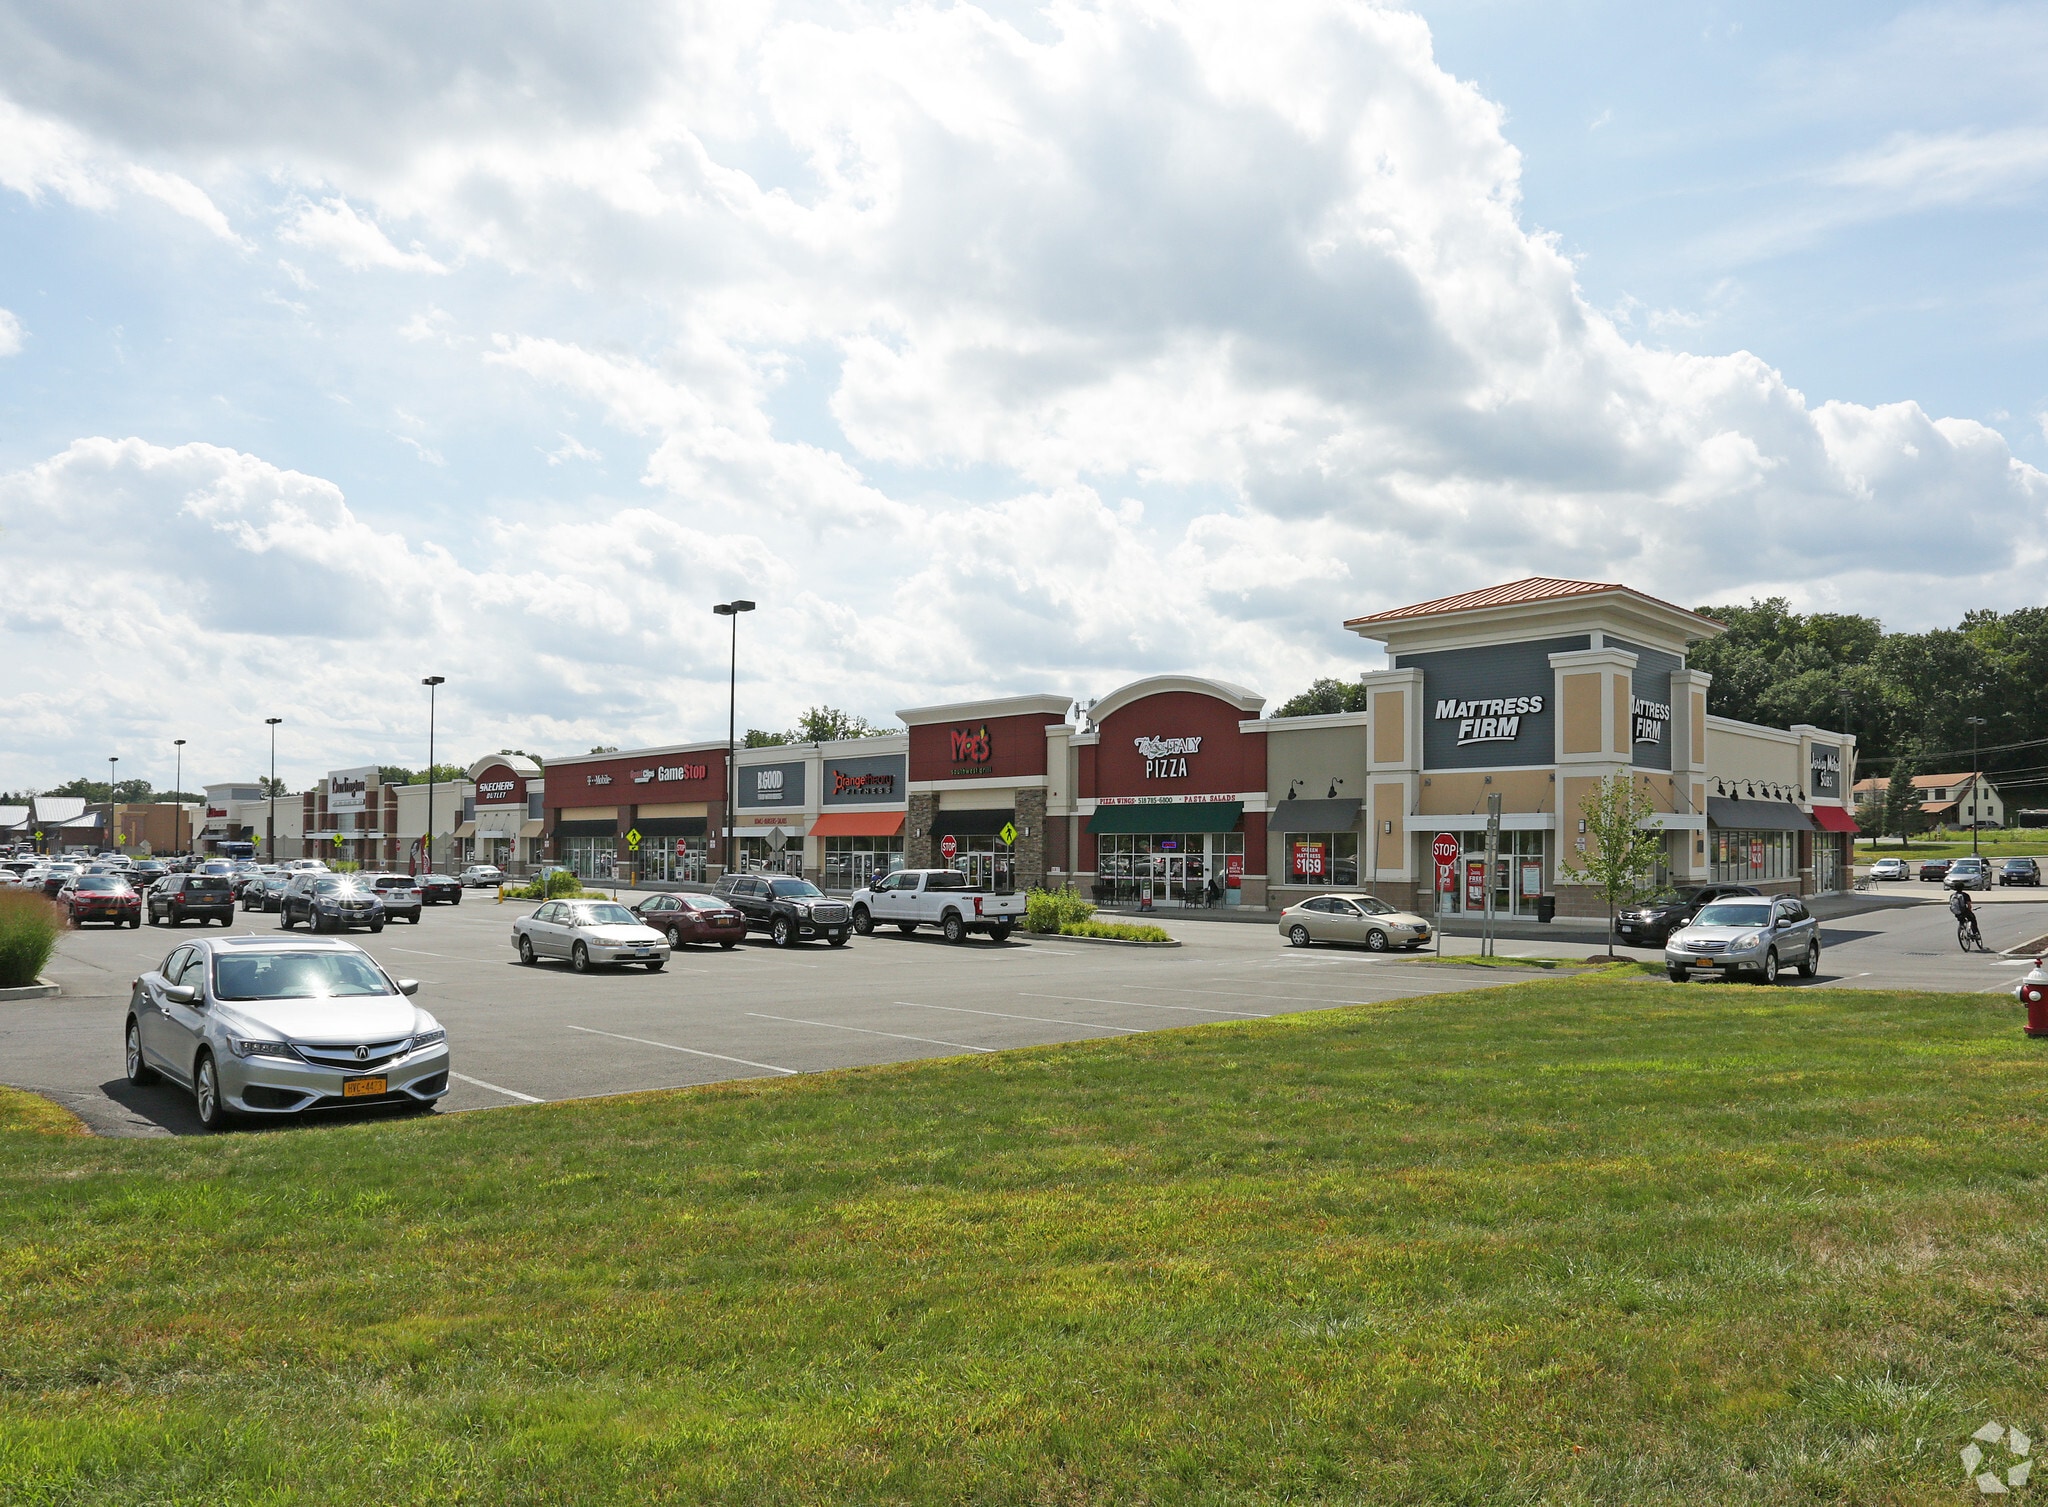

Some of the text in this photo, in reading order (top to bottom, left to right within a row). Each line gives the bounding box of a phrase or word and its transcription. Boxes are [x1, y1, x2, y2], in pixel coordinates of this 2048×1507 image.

[1435, 696, 1543, 719] MATTRESS
[1458, 716, 1520, 739] FIRM
[1636, 717, 1661, 739] FIRM
[658, 764, 706, 781] GameStop
[1146, 758, 1187, 778] PIZZA
[479, 781, 515, 792] SKECHERS
[845, 787, 892, 795] FITNESS
[942, 842, 956, 852] STOP
[1434, 843, 1457, 857] STOP
[1296, 858, 1321, 873] $169
